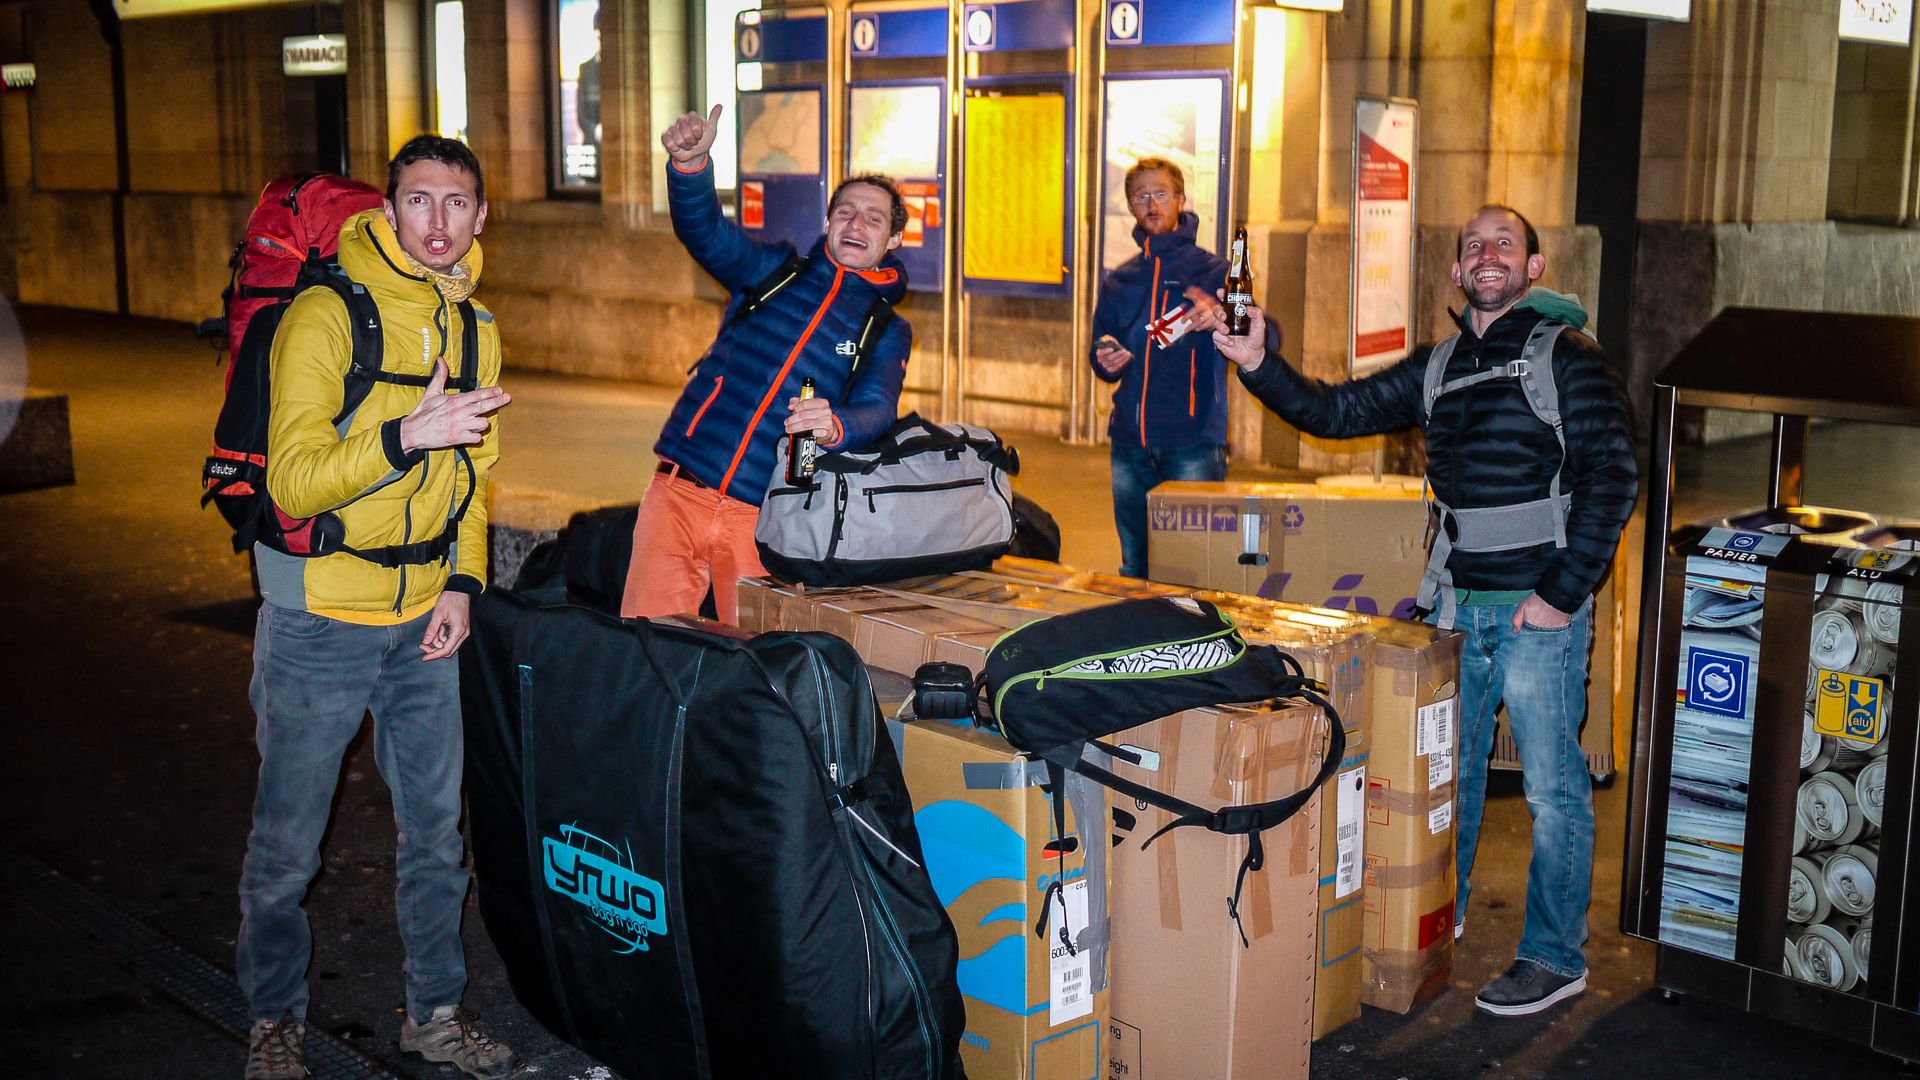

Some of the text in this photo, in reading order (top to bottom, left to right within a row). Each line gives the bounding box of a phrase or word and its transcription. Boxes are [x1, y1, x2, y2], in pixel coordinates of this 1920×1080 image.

[211, 462, 237, 476] deuter
[1704, 547, 1758, 563] PAPIER
[1847, 567, 1882, 580] ALU
[1852, 716, 1870, 728] alu
[1109, 1058, 1129, 1075] eight
